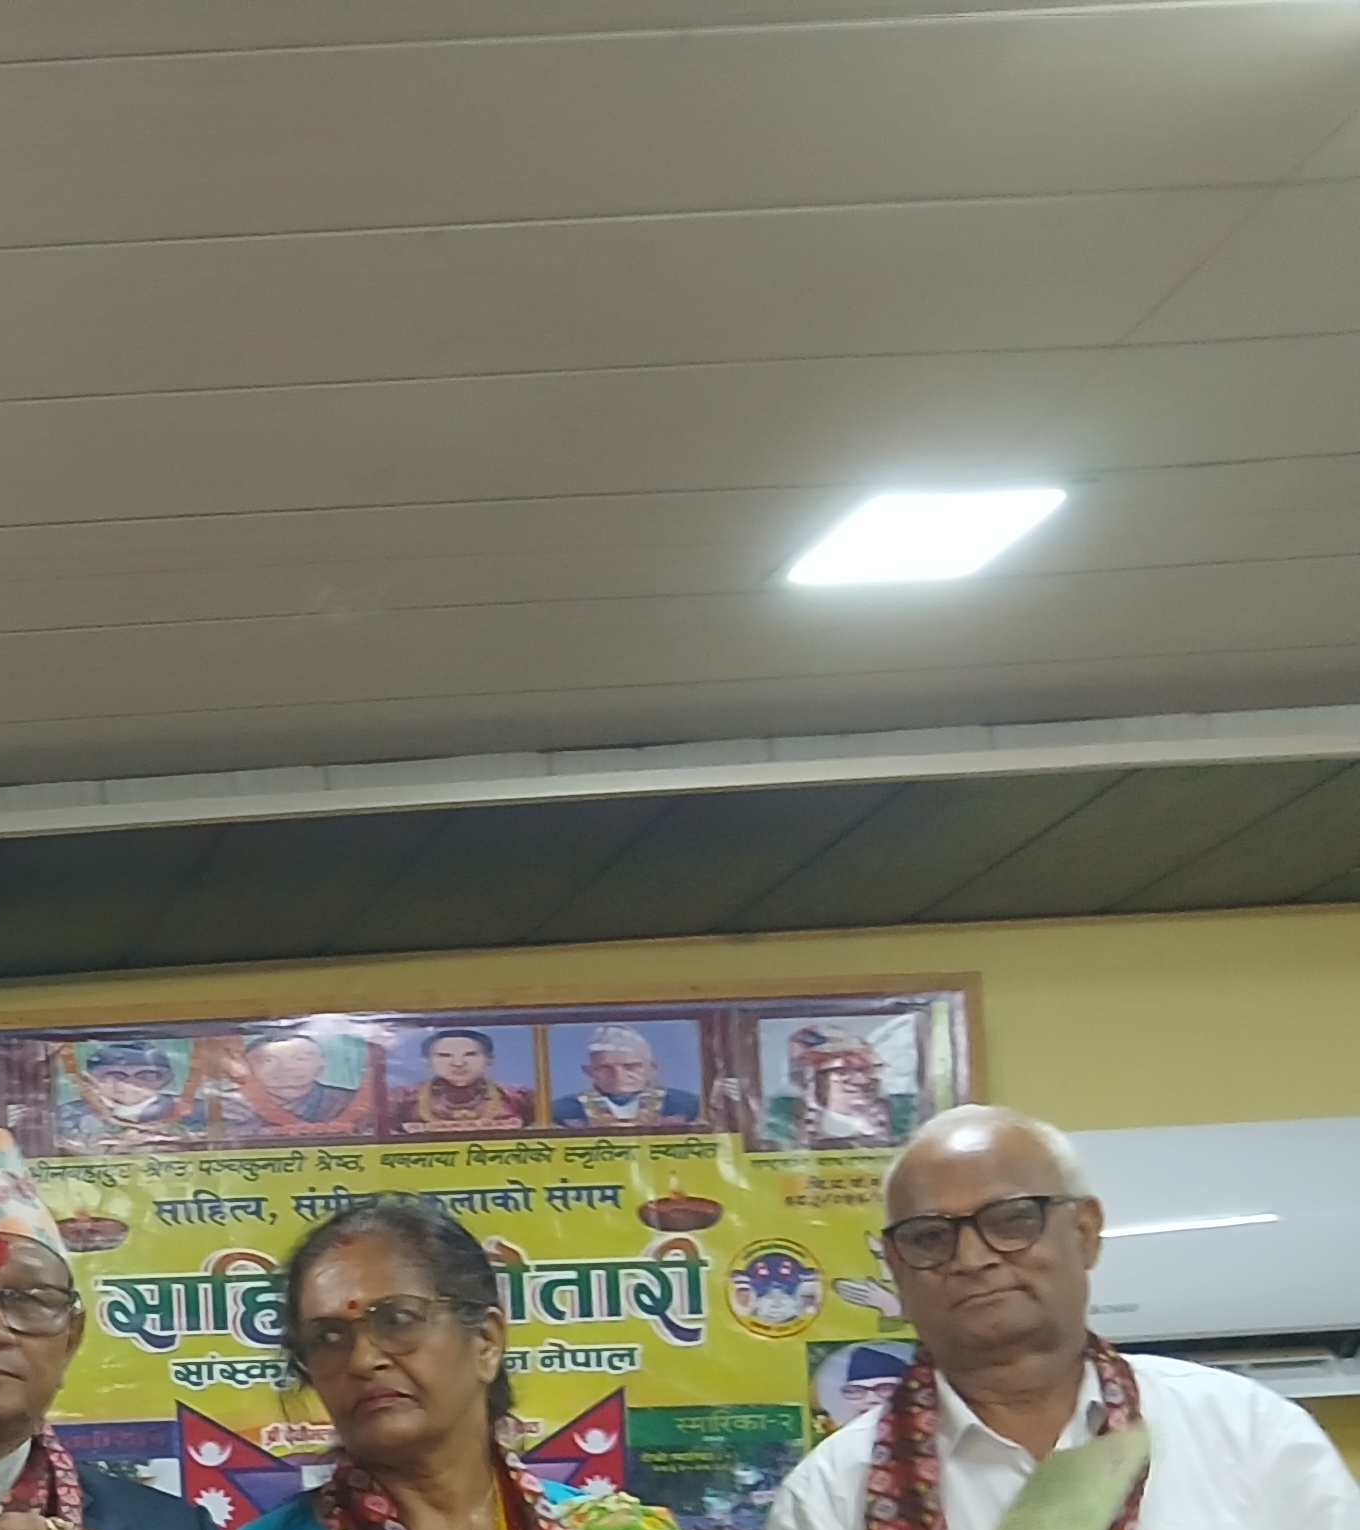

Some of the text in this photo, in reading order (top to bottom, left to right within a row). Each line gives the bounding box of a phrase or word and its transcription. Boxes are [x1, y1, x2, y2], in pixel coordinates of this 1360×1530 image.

[152, 1189, 277, 1227] साहित्य,
[544, 1177, 624, 1213] संगम
[538, 1341, 641, 1375] नेपाल
